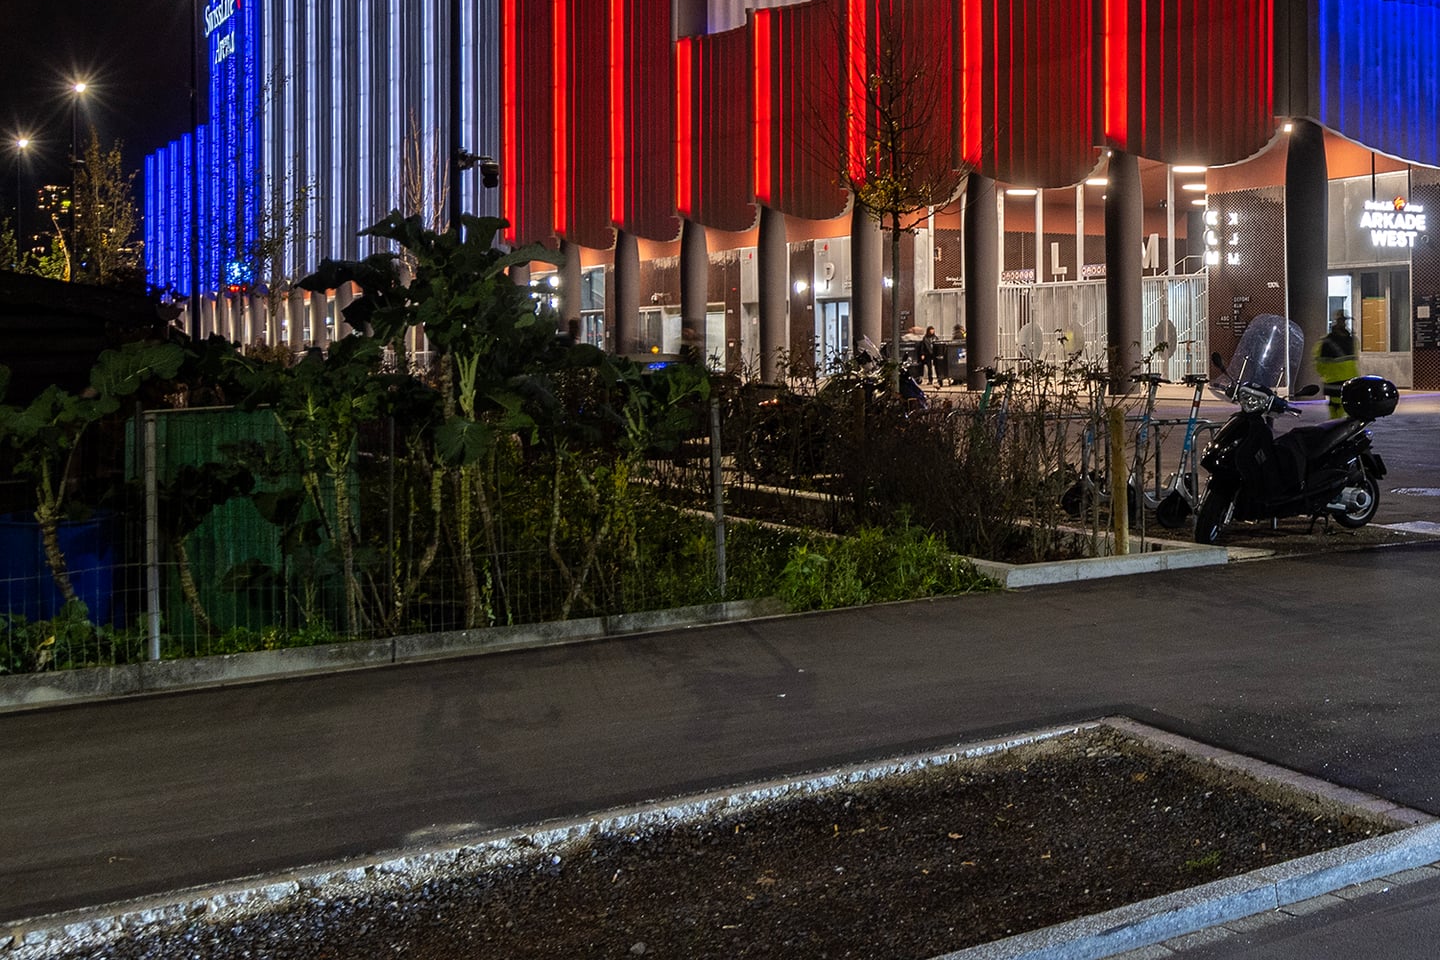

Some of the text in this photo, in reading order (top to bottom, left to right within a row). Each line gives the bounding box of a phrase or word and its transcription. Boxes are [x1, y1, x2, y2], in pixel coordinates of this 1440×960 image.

[1360, 211, 1427, 231] ARKADE
[1207, 230, 1218, 245] L
[1370, 229, 1418, 248] WEST
[1051, 242, 1067, 274] L
[824, 262, 835, 291] P
